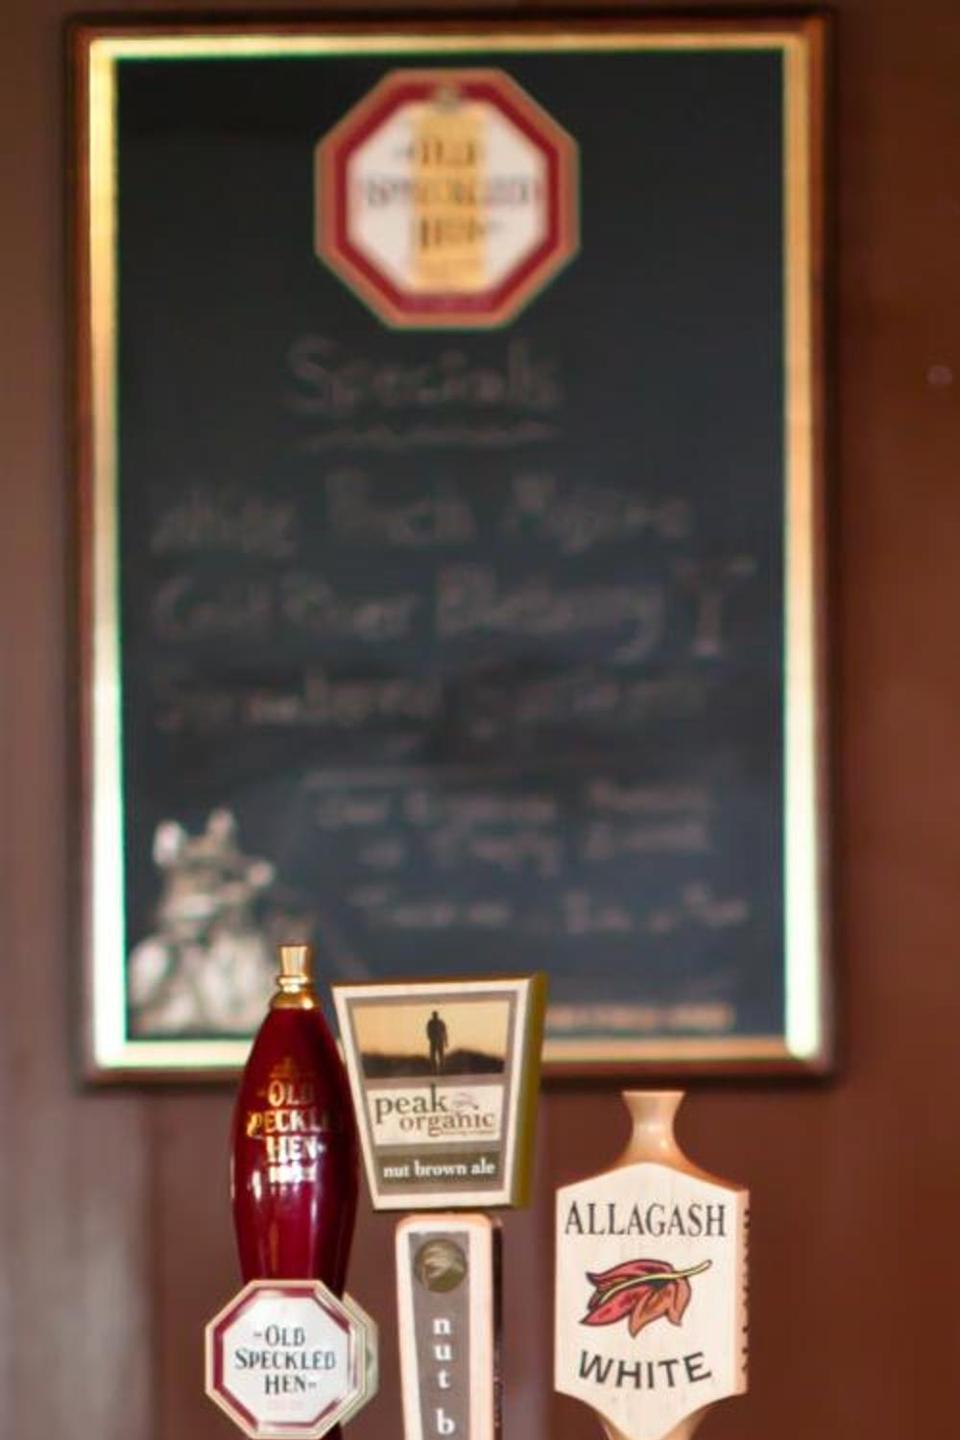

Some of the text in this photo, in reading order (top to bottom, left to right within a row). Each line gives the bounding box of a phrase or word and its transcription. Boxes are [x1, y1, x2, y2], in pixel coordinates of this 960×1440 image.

[375, 1083, 448, 1124] peak
[399, 1106, 495, 1137] organic
[384, 1157, 496, 1178] nut brown ale
[564, 1201, 727, 1237] ALLAGASH
[235, 1348, 336, 1370] SPECKLED
[433, 1318, 452, 1388] nut
[578, 1350, 713, 1389] WHITE
